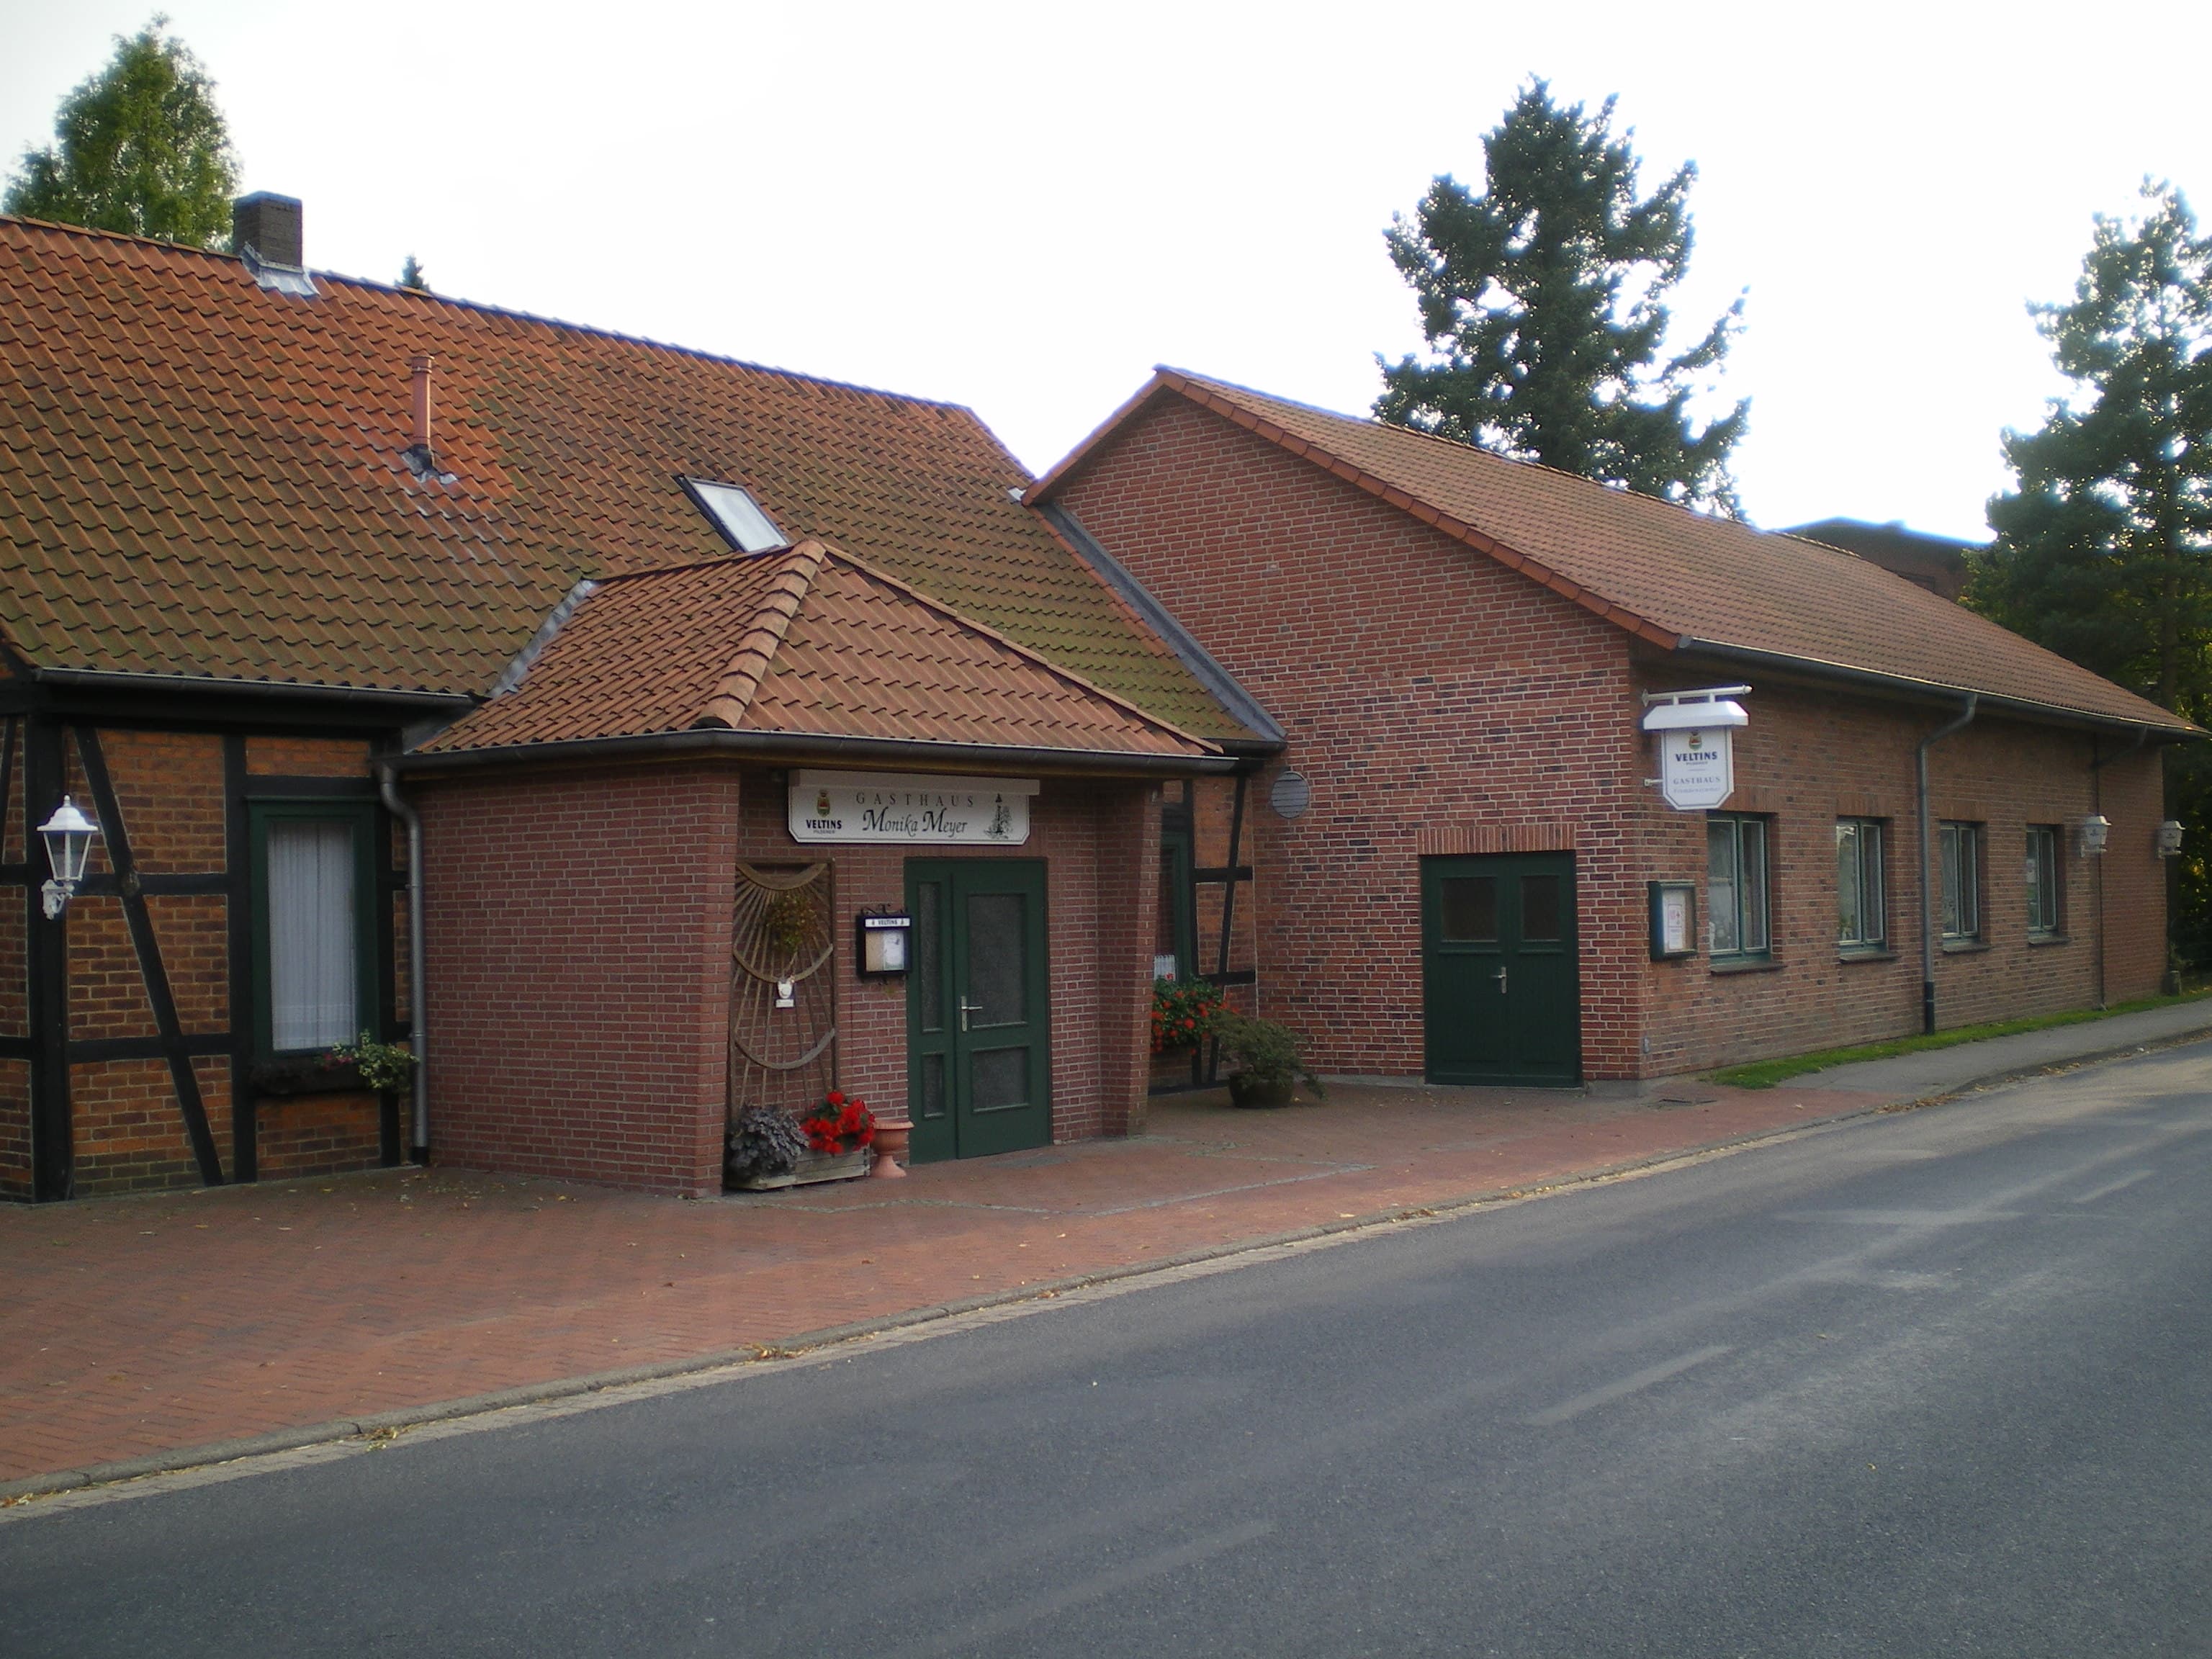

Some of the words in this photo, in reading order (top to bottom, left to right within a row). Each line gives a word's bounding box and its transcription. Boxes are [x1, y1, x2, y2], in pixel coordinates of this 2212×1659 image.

[1676, 751, 1717, 762] VELTINS
[1673, 776, 1720, 785] GASTHAUS
[856, 792, 974, 807] GASTHAUS
[806, 819, 842, 830] VELTINS
[862, 806, 919, 837] Monika
[922, 807, 968, 838] Meyer
